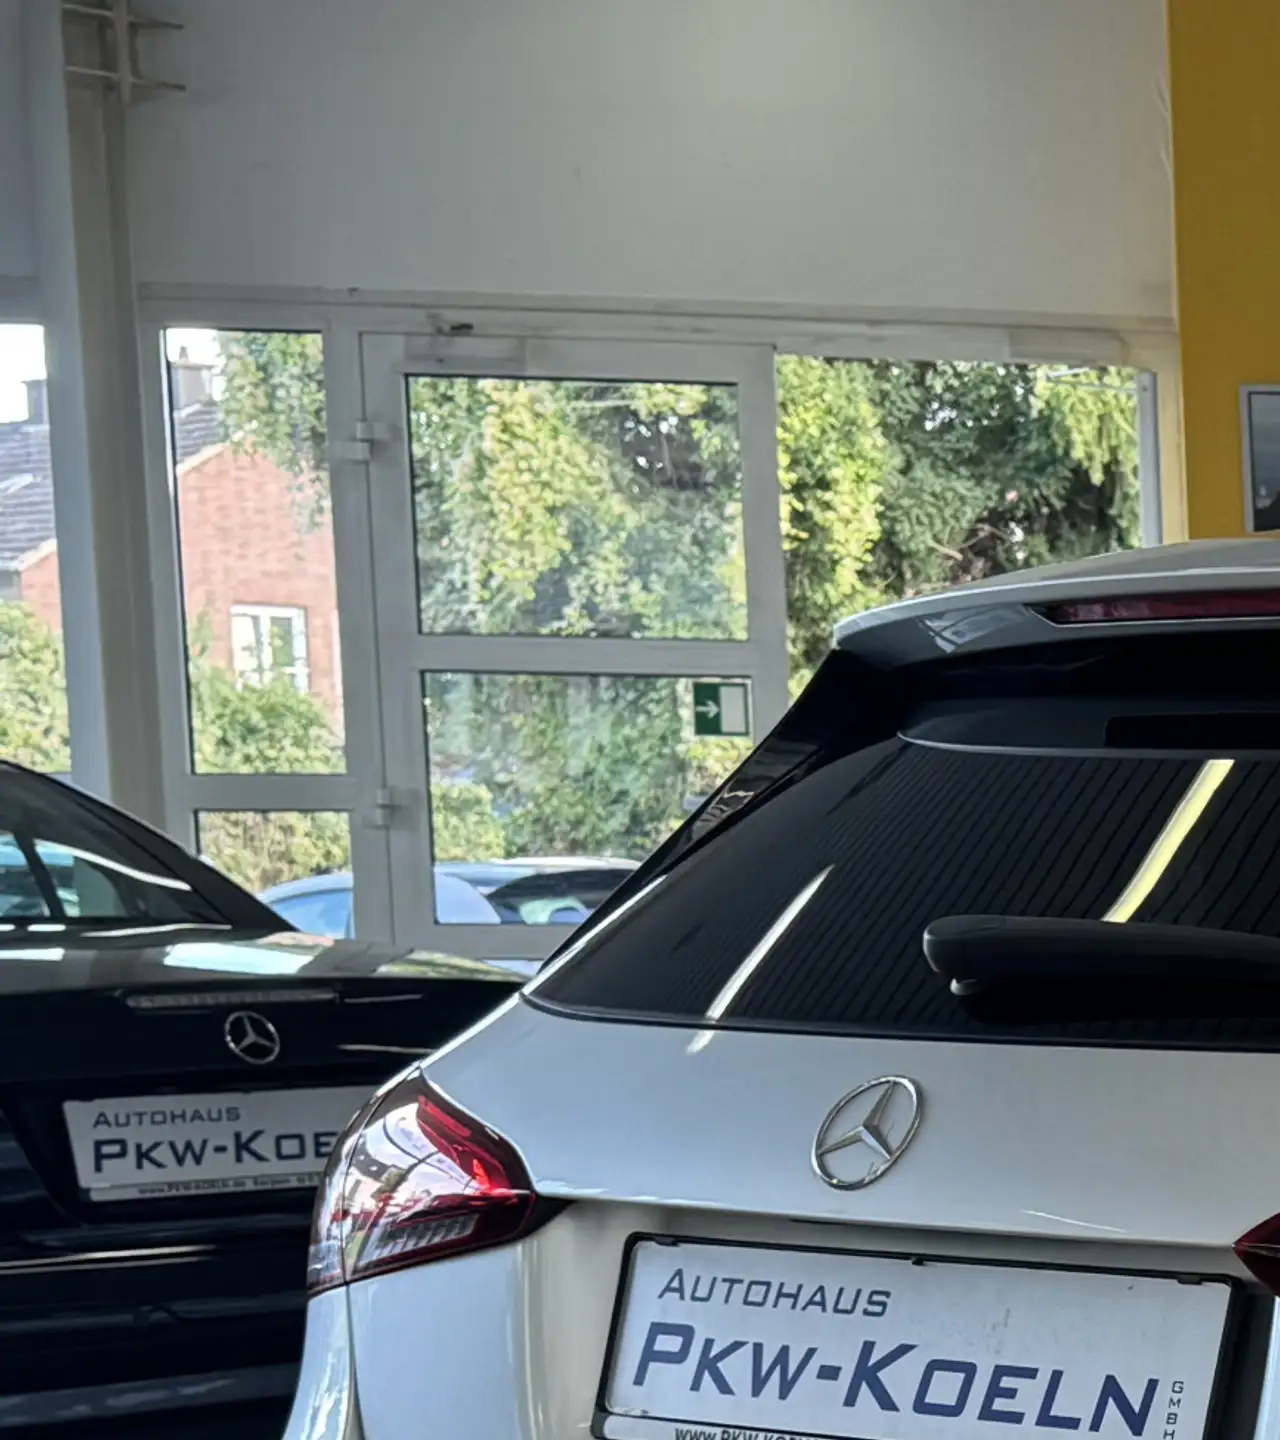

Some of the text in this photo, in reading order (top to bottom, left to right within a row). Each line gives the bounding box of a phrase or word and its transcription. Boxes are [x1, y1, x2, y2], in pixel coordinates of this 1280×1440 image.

[93, 1107, 241, 1128] AUTOHAUS
[94, 1129, 339, 1174] PKW-KOE
[659, 1268, 891, 1317] AUTOHAUS
[633, 1321, 1159, 1437] PKW-KOELN
